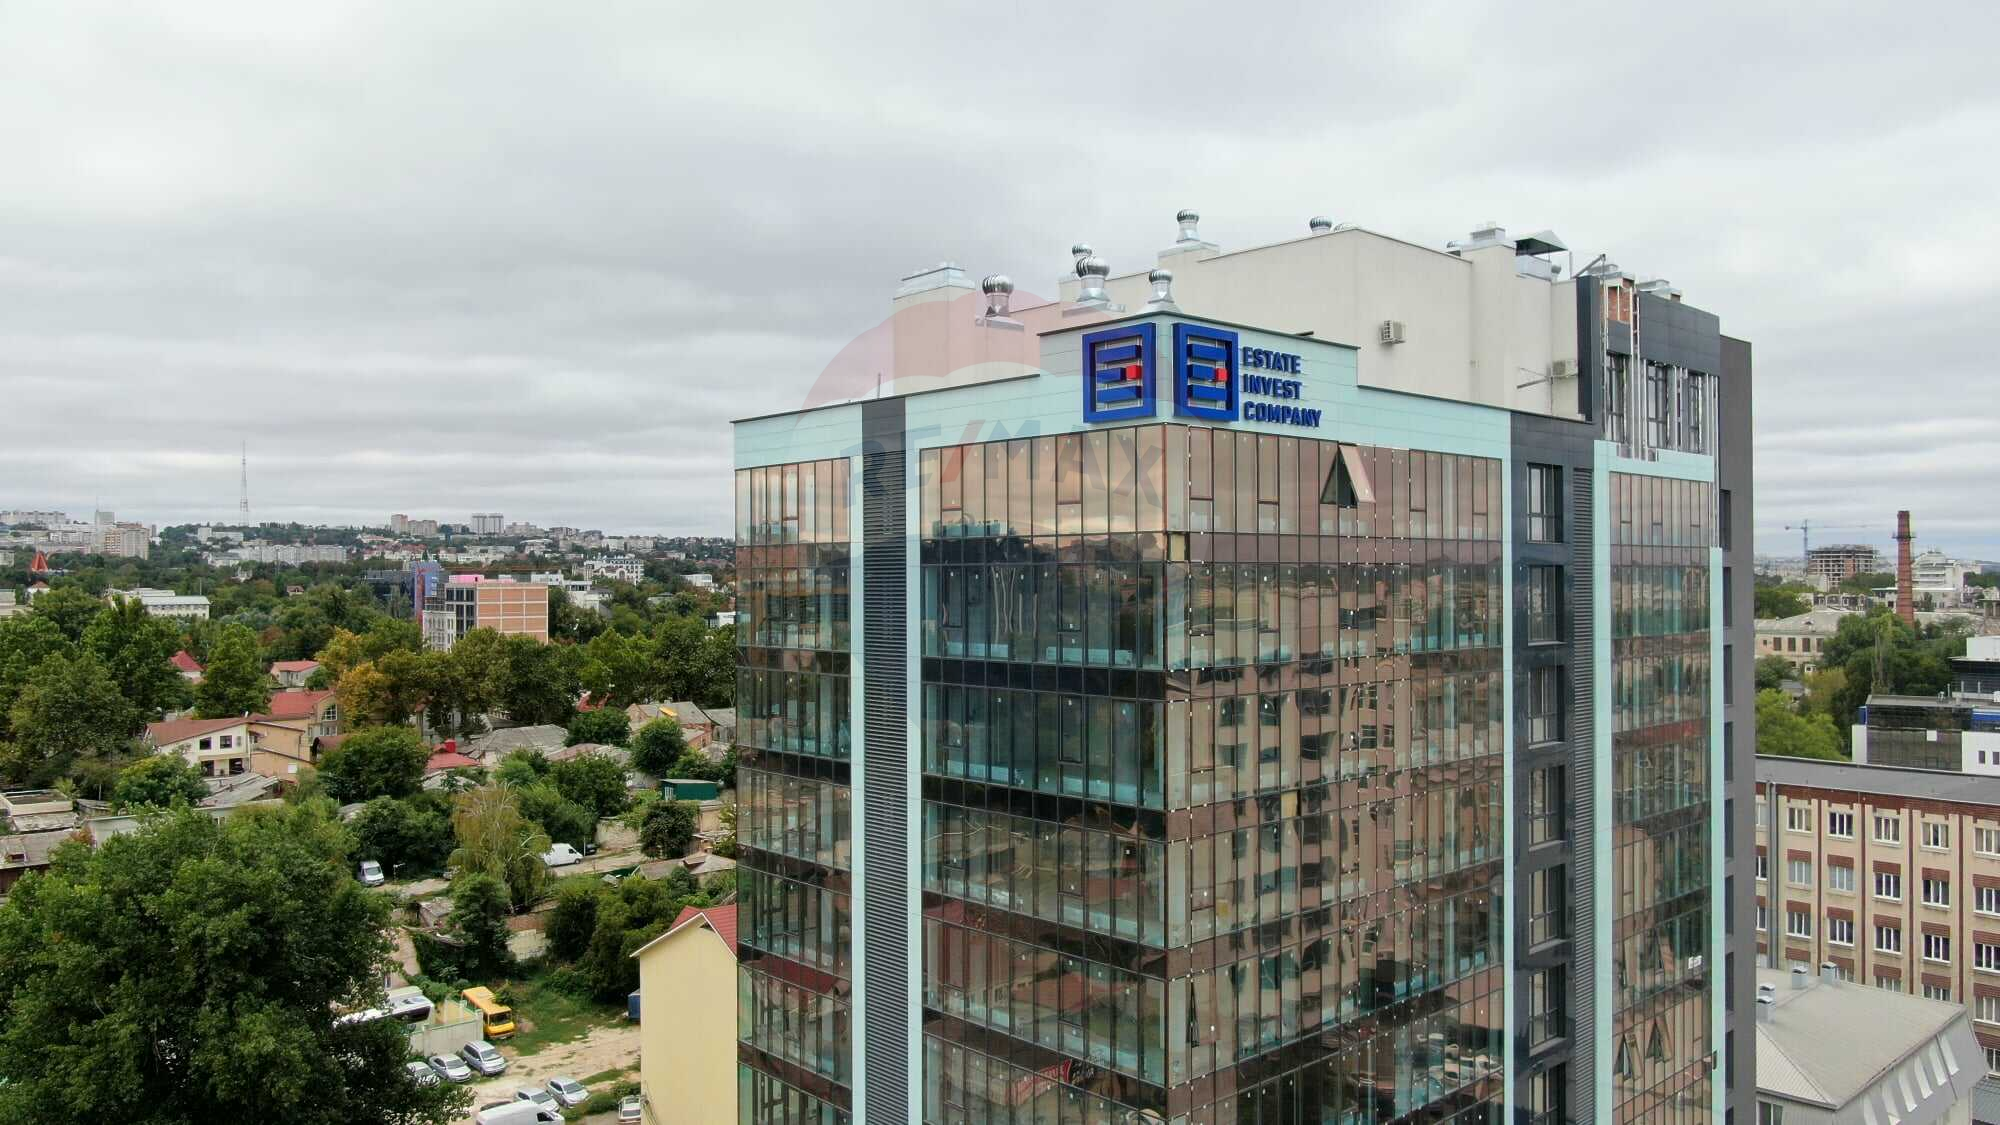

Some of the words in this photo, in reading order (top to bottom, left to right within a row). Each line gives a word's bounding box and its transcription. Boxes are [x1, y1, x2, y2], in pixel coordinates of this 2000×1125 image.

[1242, 346, 1301, 374] ESTATE
[1243, 373, 1302, 400] INVEST
[1244, 401, 1322, 427] COMPANY
